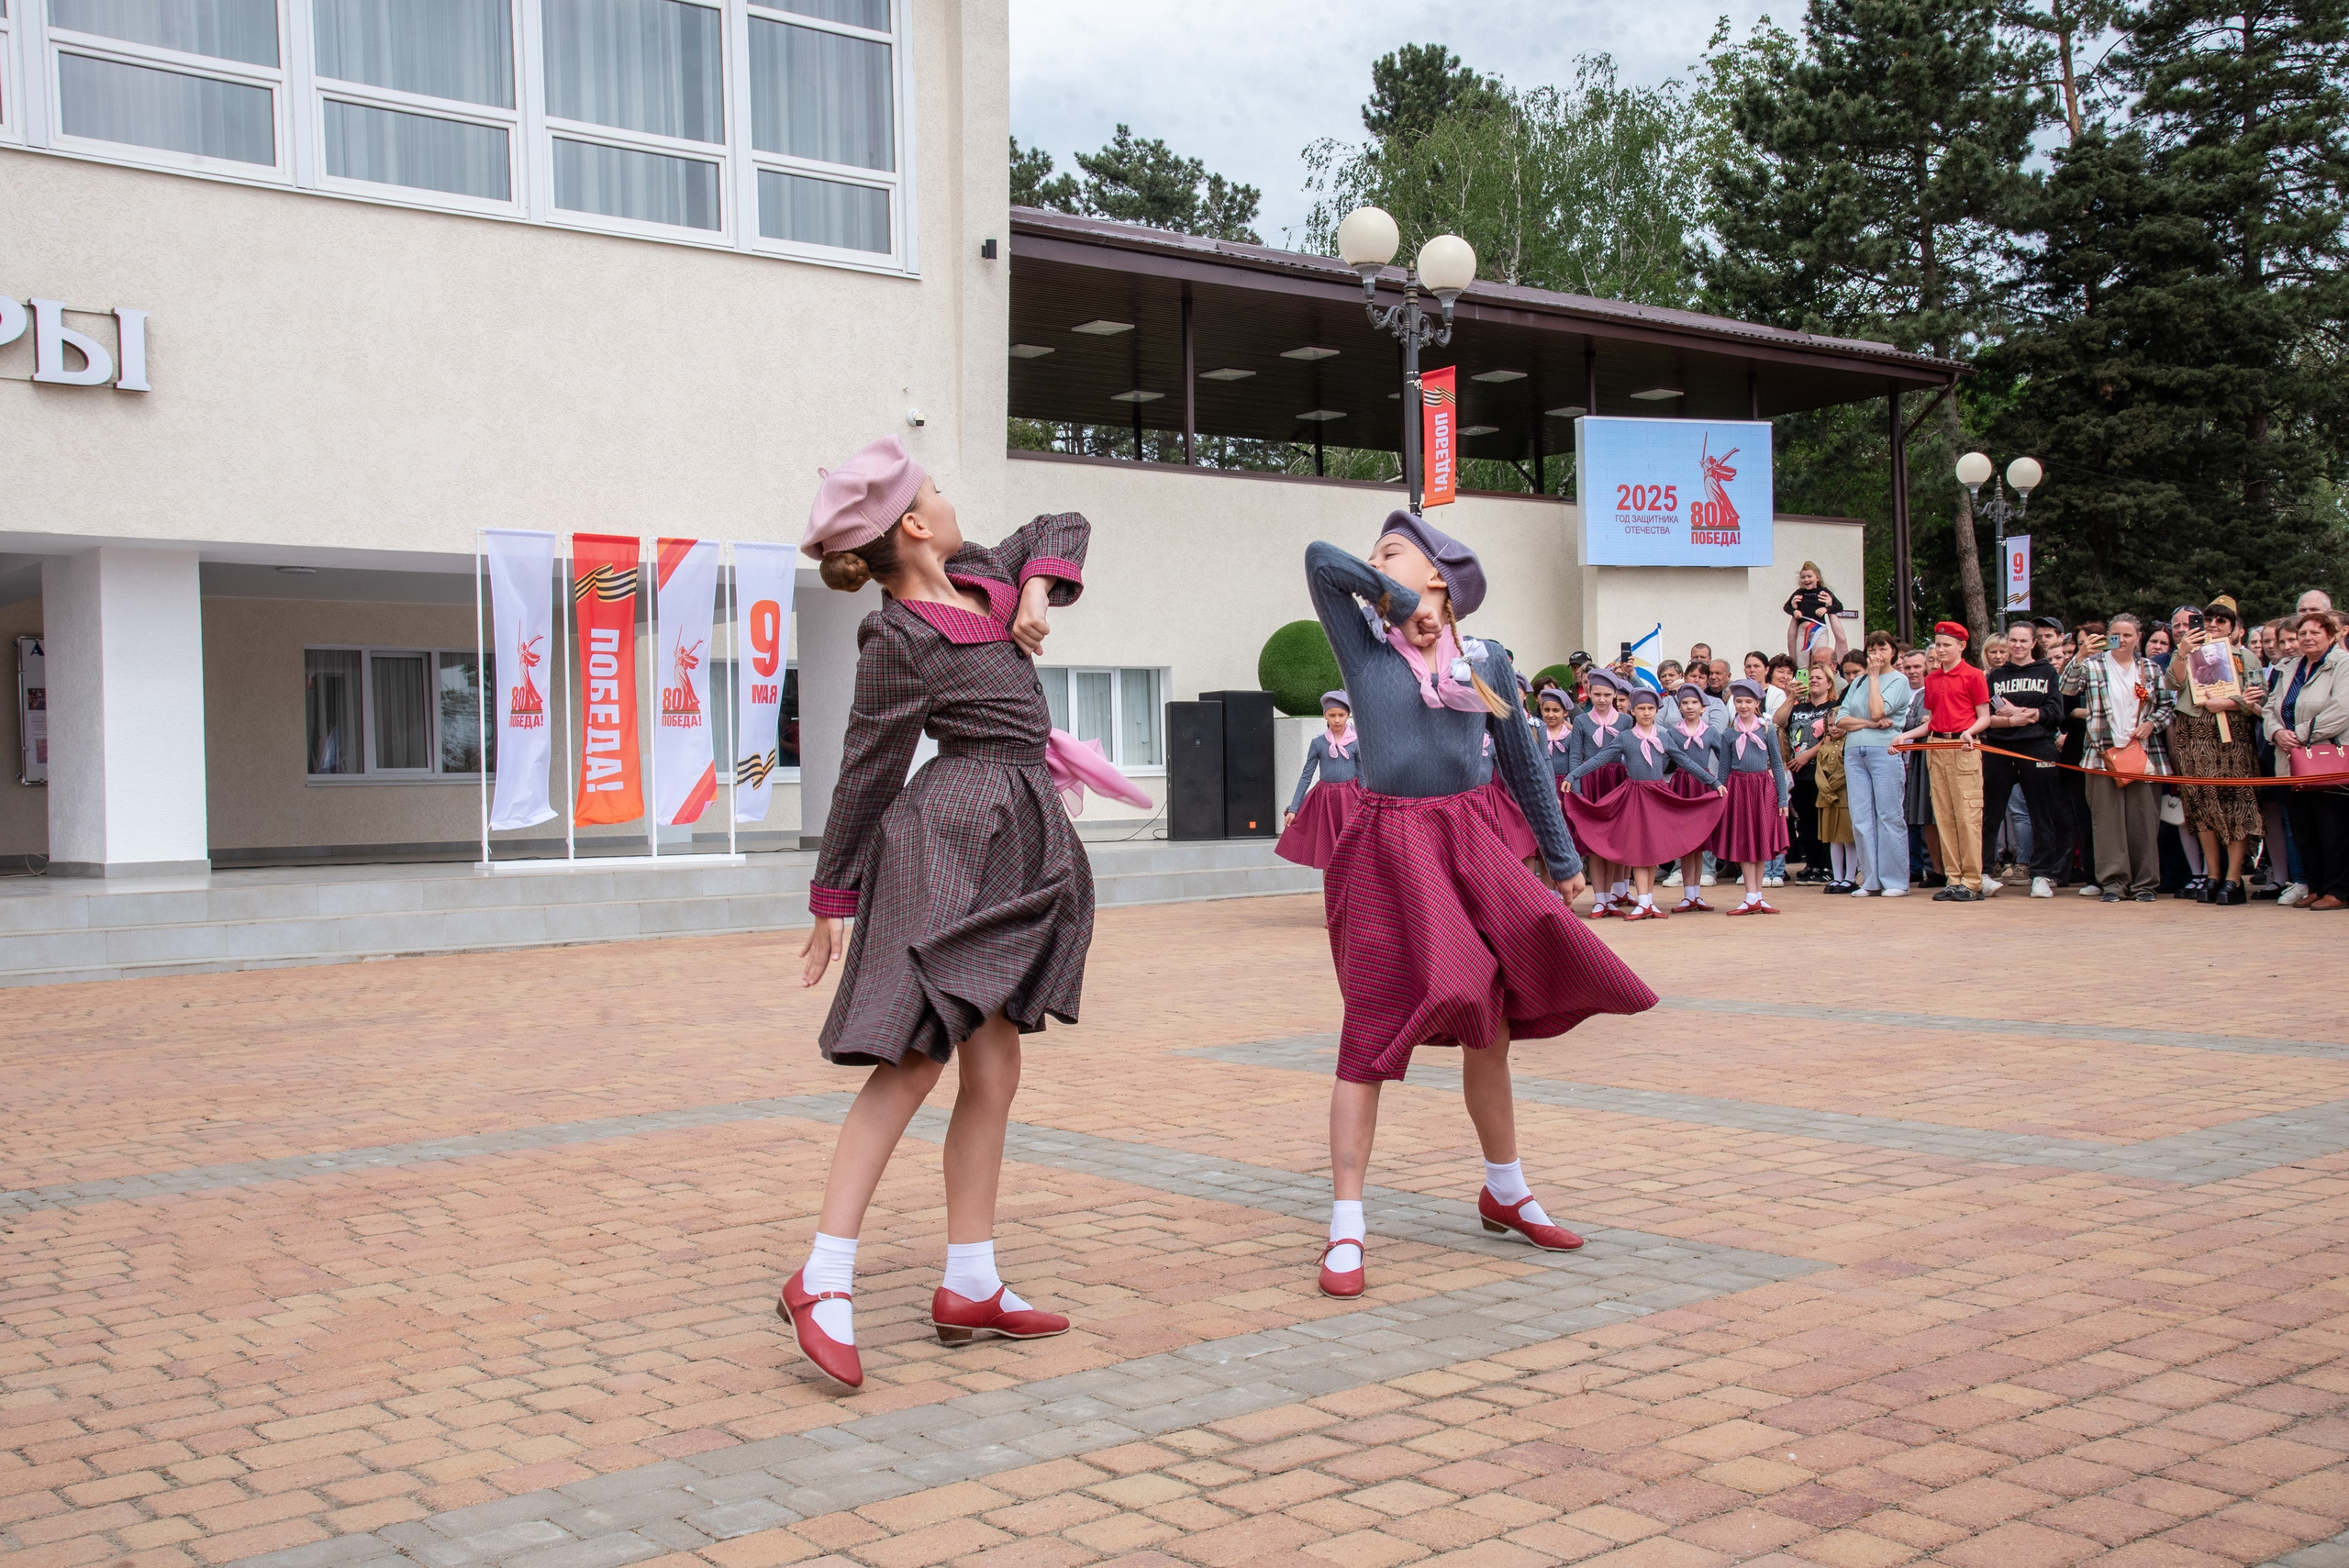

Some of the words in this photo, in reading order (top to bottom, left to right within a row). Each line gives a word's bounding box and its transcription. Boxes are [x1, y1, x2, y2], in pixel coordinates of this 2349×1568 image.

[1616, 484, 1678, 512] 2025
[1615, 515, 1631, 524] ГОД
[1631, 515, 1679, 525] ЗАЩИТНИКА
[1690, 501, 1718, 527] 80
[1624, 526, 1671, 535] ОТЕЧЕСТВА
[1691, 531, 1741, 547] ПОБЕДА!
[2012, 551, 2024, 574] 9
[750, 599, 781, 678] 9
[511, 685, 526, 711] 80
[662, 687, 683, 711] 80
[751, 684, 778, 705] МАЯ
[508, 714, 544, 729] ПОБЕДА!
[585, 628, 625, 793] ПОБЕДА!
[662, 714, 702, 729] ПОБЕДА!
